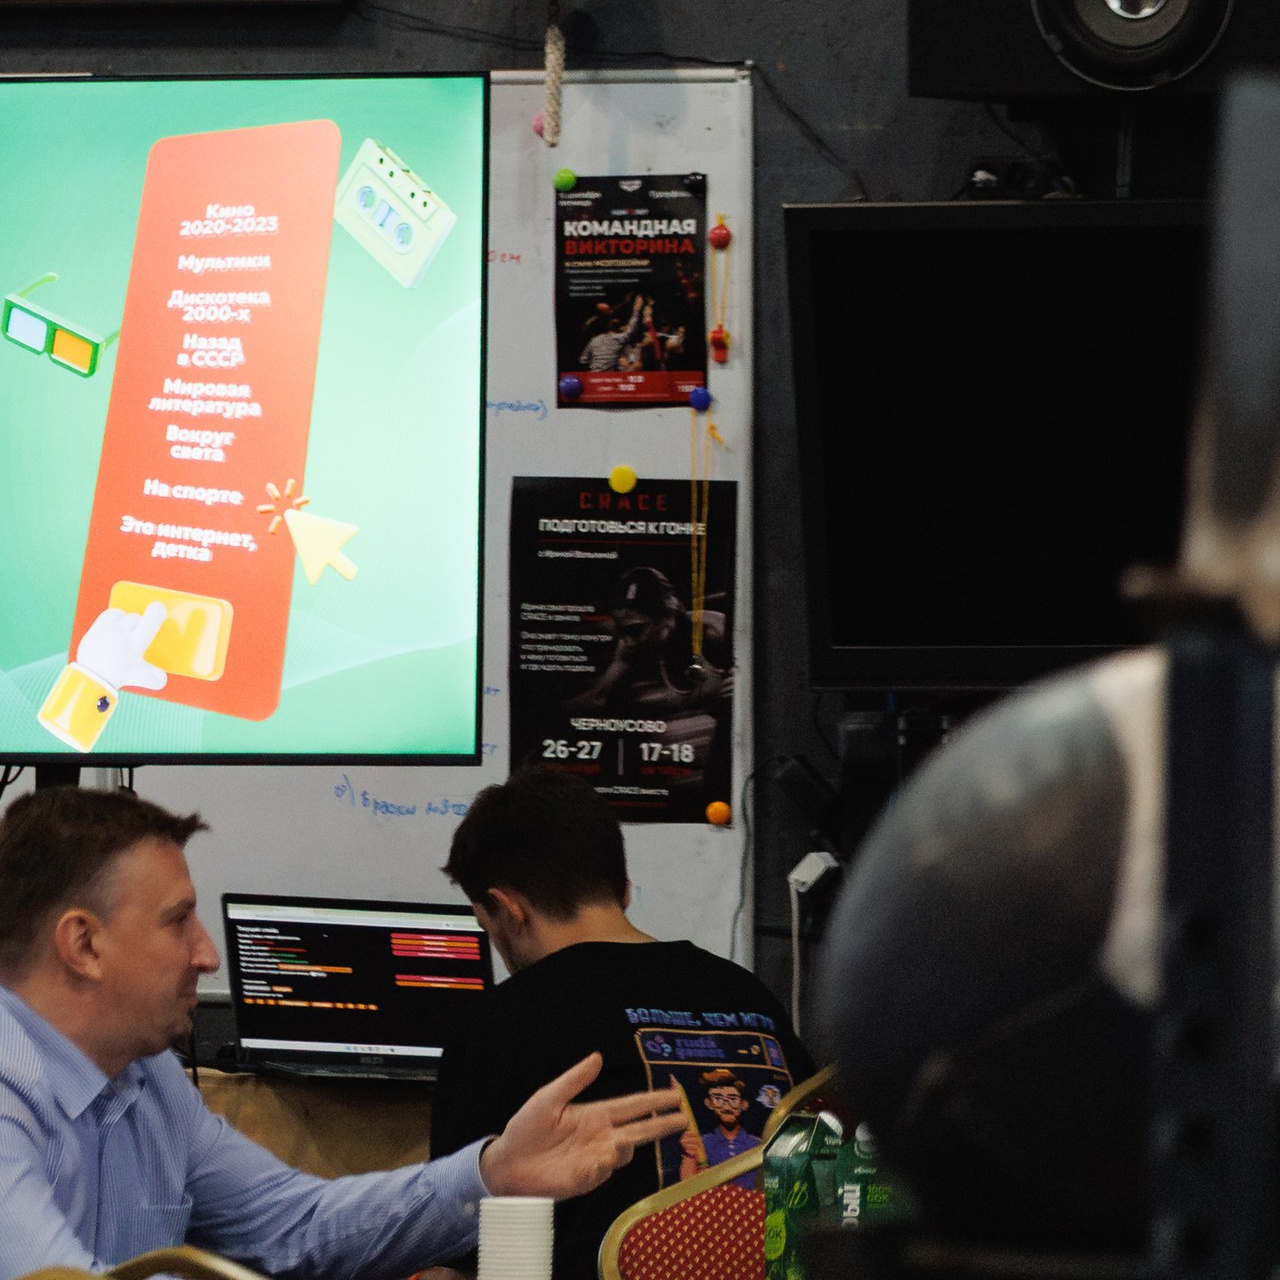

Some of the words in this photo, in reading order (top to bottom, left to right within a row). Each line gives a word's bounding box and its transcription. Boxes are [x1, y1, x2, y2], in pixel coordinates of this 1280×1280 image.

[206, 204, 255, 219] Кино
[180, 216, 279, 236] 2020-2023
[563, 219, 697, 238] КОМАНДНАЯ
[564, 239, 696, 255] ВИКТОРИНА
[178, 255, 271, 273] Мультики
[167, 290, 270, 308] Дискотека
[182, 305, 251, 321] 2000-х
[183, 333, 242, 351] Назад
[177, 352, 189, 366] в
[192, 351, 245, 367] СССР
[163, 378, 251, 398] Мировая
[148, 397, 262, 418] литература
[166, 424, 235, 447] Вокруг
[170, 445, 225, 462] света
[144, 478, 170, 497] На
[172, 485, 244, 505] спорте
[120, 515, 155, 535] Это
[157, 523, 258, 552] интернет,
[538, 518, 647, 534] ПОДГОТОВЬСЯ
[648, 521, 658, 534] К
[659, 522, 707, 536] ГОНКЕ
[151, 541, 213, 562] детка
[570, 717, 668, 733] ЧЕРНОУСОВО
[542, 739, 603, 759] 26-27
[639, 742, 696, 762] 17-18
